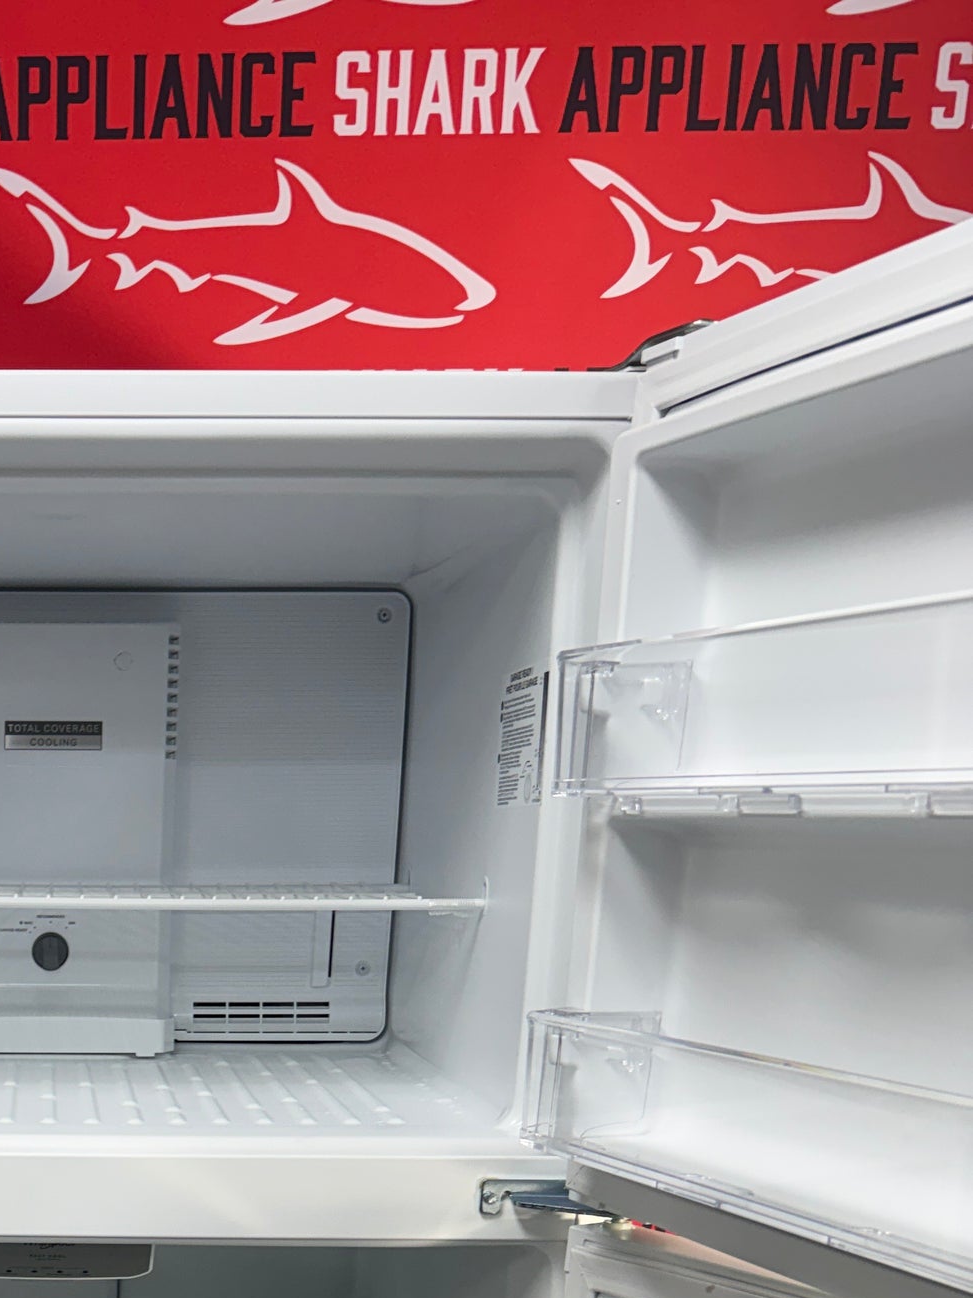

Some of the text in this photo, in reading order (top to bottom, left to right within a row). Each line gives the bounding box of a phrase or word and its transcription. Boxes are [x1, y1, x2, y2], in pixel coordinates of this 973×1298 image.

[334, 48, 545, 136] SHARK
[560, 43, 918, 132] APPLIANCE
[7, 724, 100, 733] TOTAL COVERAGE
[29, 738, 77, 747] COOLING
